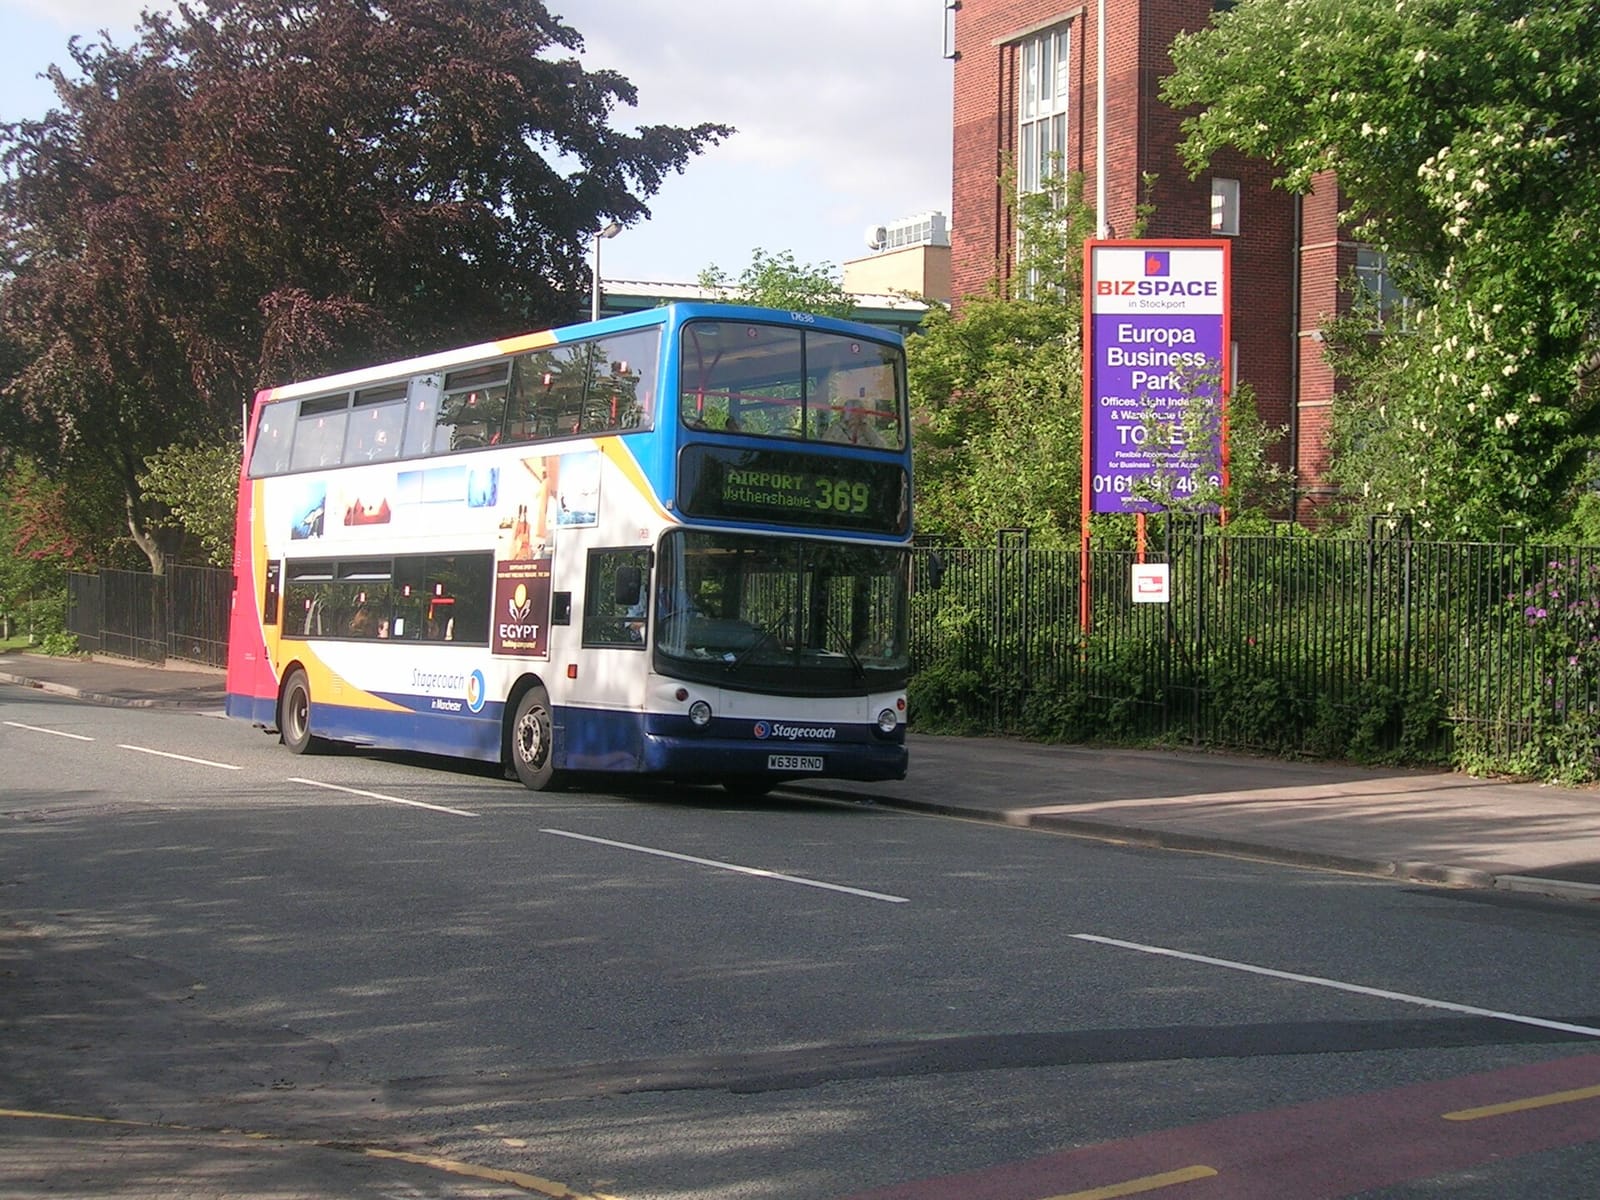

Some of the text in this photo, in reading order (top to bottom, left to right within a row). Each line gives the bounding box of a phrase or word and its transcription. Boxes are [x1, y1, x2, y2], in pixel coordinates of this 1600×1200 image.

[1097, 280, 1218, 296] BIZSPACE
[1128, 299, 1186, 310] in Stockport
[1118, 323, 1196, 347] Europa
[1107, 347, 1206, 367] Business
[1131, 371, 1181, 390] Park
[1101, 396, 1139, 408] Offices,
[1111, 410, 1119, 420] &
[1116, 425, 1149, 444] TO
[1115, 451, 1141, 459] Flexible
[727, 469, 803, 490] AIRPORT
[1093, 474, 1133, 493] 0161
[815, 479, 869, 513] 369
[499, 624, 539, 639] EGYPT
[411, 667, 464, 693] Stagecoach
[772, 723, 836, 740] Stagecoach
[800, 757, 822, 769] RND
